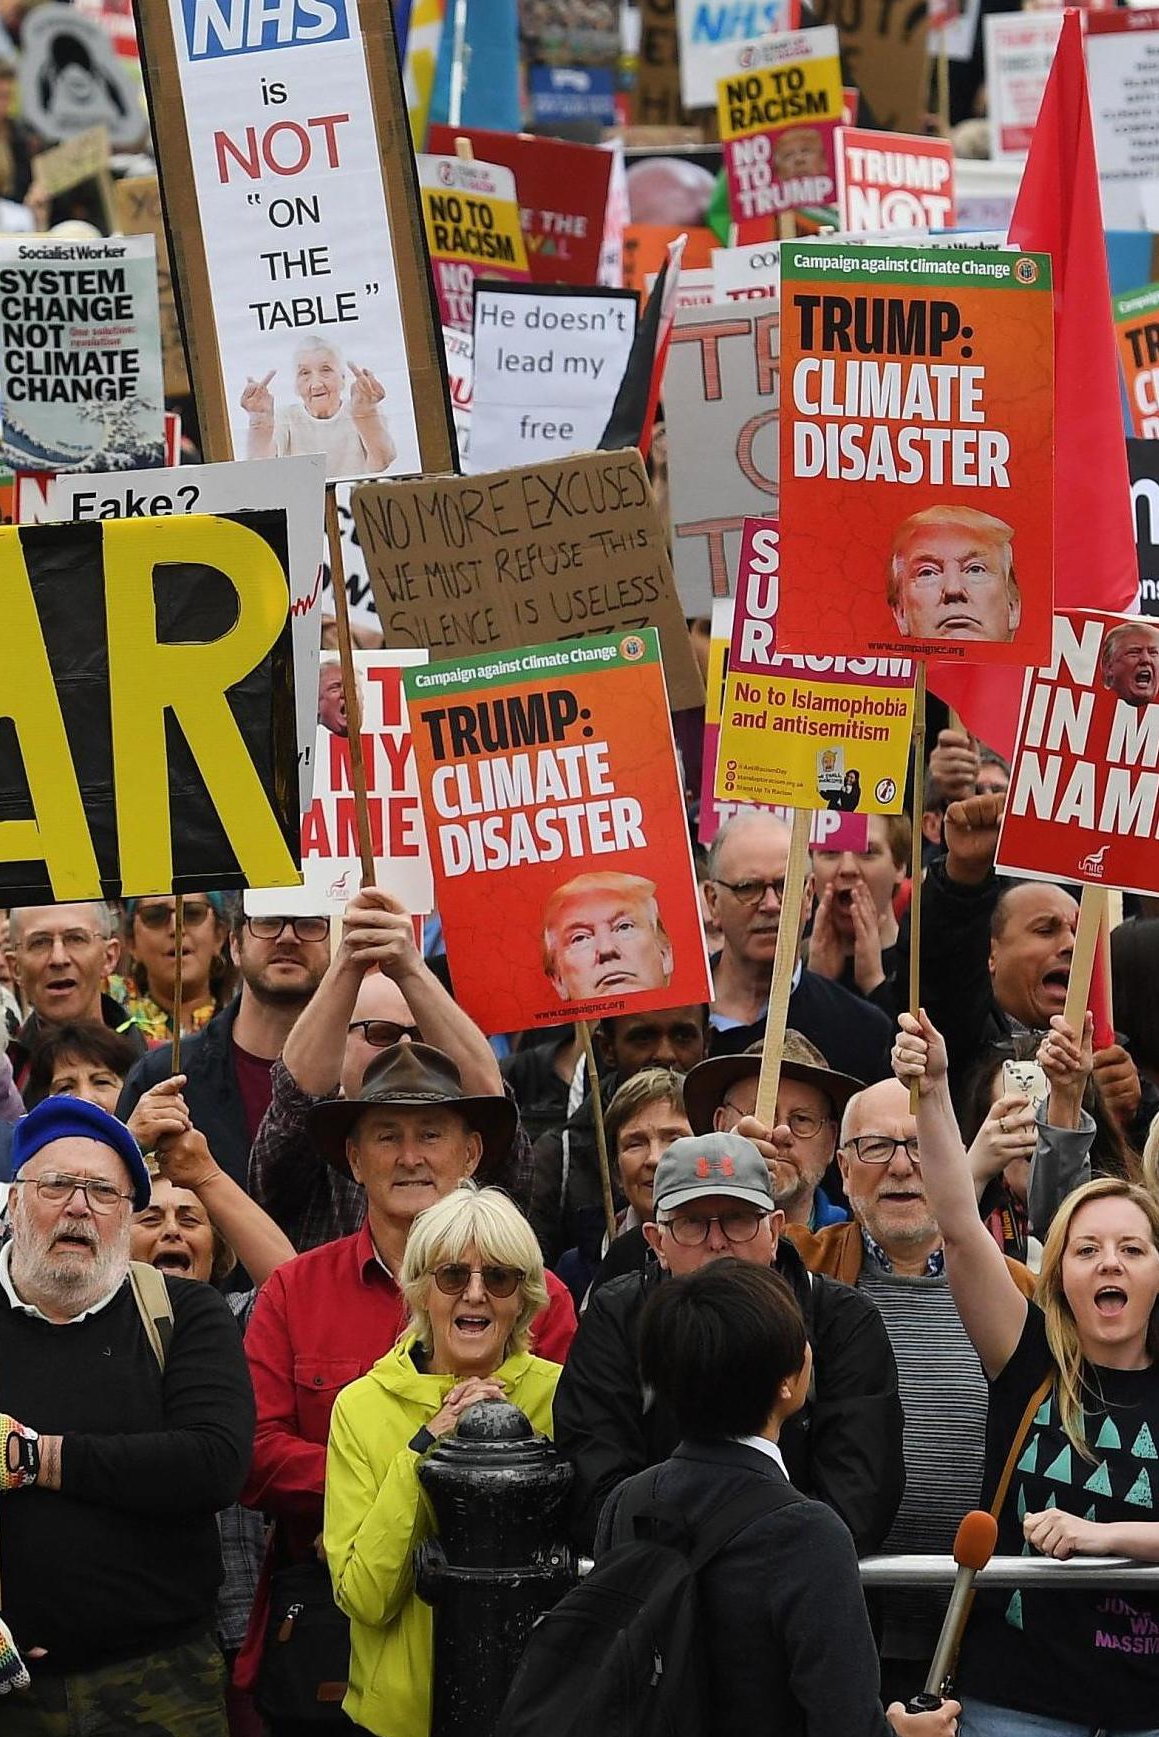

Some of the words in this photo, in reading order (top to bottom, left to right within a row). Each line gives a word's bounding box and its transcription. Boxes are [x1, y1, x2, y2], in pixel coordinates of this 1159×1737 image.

[193, 0, 338, 54] NHS
[693, 1, 779, 43] NHS
[260, 78, 287, 106] is
[726, 75, 762, 104] NO
[770, 67, 806, 98] TO
[731, 90, 829, 131] RACISM
[213, 114, 350, 184] NOT
[732, 136, 771, 164] NO
[738, 160, 772, 188] TO
[846, 147, 951, 191] TRUMP
[429, 195, 462, 223] NO
[466, 201, 493, 229] TO
[738, 175, 833, 217] TRUMP
[18, 246, 74, 260] Socialist
[76, 246, 126, 259] Worker
[433, 224, 516, 263] RACISM
[260, 247, 331, 281] THE
[439, 263, 474, 293] NO
[794, 254, 860, 272] Campaign
[862, 257, 909, 275] against
[910, 258, 960, 275] Climate
[962, 261, 1010, 279] Change
[0, 269, 125, 295] SYSTEM
[1, 295, 134, 322] CHANGE
[481, 303, 515, 328] He
[525, 305, 627, 331] doesn't
[794, 294, 973, 358] TRUMP:
[4, 323, 65, 348] NOT
[5, 349, 140, 375] CLIMATE
[497, 348, 553, 373] lead
[562, 355, 604, 379] my
[6, 377, 138, 402] CHANGE
[793, 358, 985, 423] CLIMATE
[520, 414, 574, 440] free
[793, 421, 1010, 488] DISASTER
[72, 485, 200, 520] Fake?
[359, 499, 412, 554] NO
[413, 479, 518, 549] MORE
[423, 560, 482, 600] MUST
[495, 541, 583, 583] REFUSE
[589, 529, 648, 558] THIS
[392, 609, 501, 649] SILENCE
[514, 599, 539, 625] IS
[550, 566, 670, 624] USELESS!
[868, 640, 964, 656] www.campaigncc.org
[415, 667, 477, 690] Campaign
[477, 660, 520, 681] against
[522, 652, 569, 673] Climate
[570, 645, 617, 666] Change
[734, 682, 760, 703] No
[767, 685, 786, 706] to
[792, 687, 907, 719] Islamophobia
[421, 690, 594, 761] TRUMP:
[731, 708, 767, 730] and
[773, 716, 890, 743] antisemitism
[1025, 684, 1095, 756] IN
[431, 741, 615, 819] CLIMATE
[438, 797, 648, 877] DISASTER
[535, 1001, 625, 1021] www.campaigncc.org
[1002, 1210, 1015, 1240] Nikon
